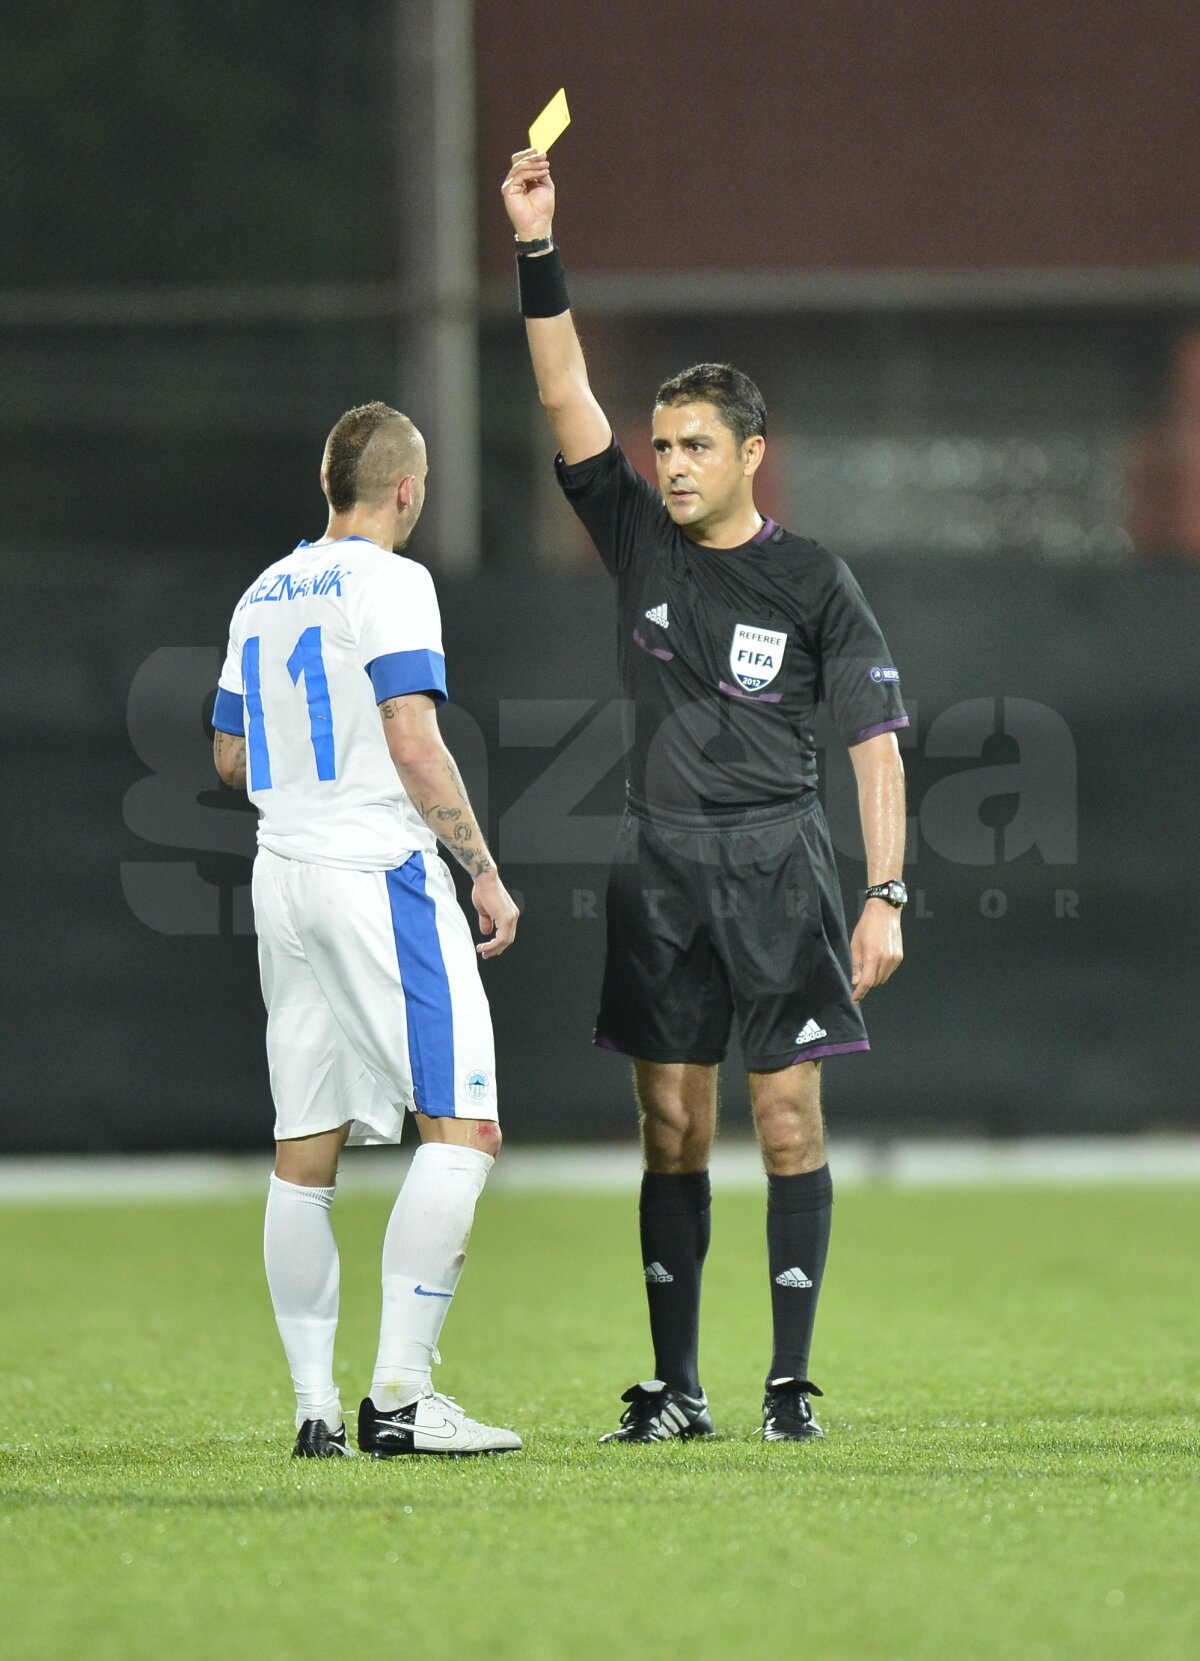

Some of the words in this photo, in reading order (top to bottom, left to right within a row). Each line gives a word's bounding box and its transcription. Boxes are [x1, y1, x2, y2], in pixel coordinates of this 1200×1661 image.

[739, 630, 782, 646] REFEREE
[737, 649, 774, 669] FIFA
[742, 676, 761, 687] 2012
[241, 626, 336, 792] 11
[796, 1029, 827, 1044] adidas
[775, 1277, 813, 1289] adidas
